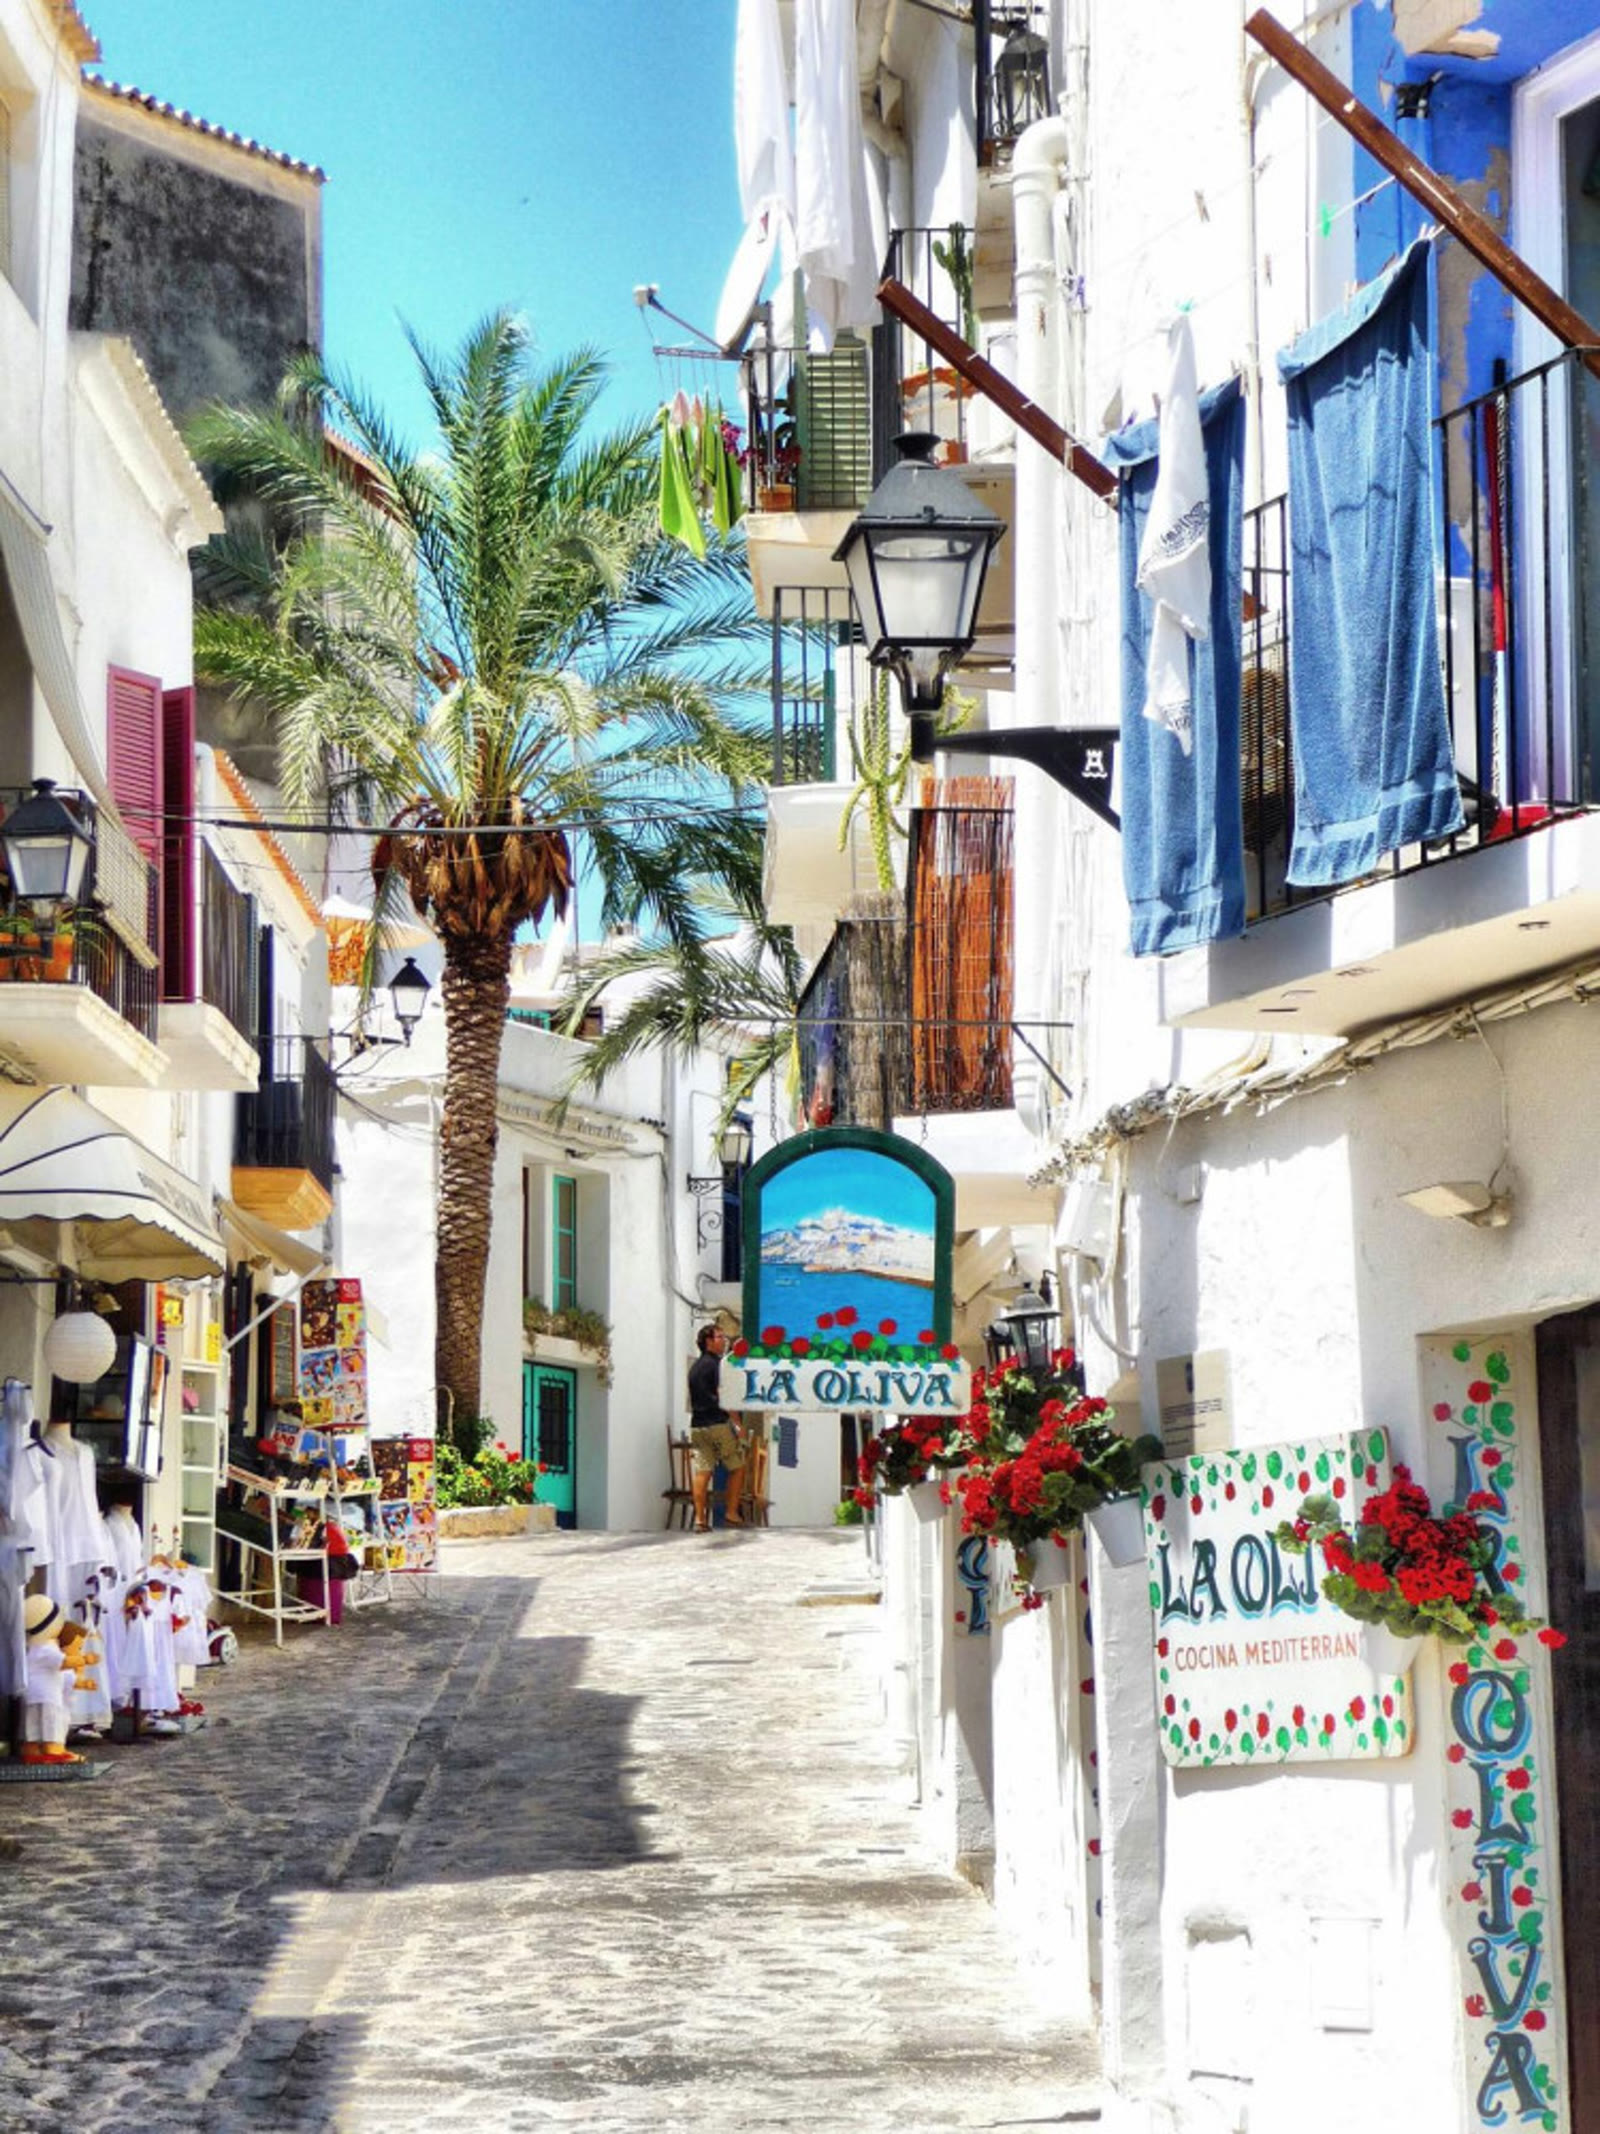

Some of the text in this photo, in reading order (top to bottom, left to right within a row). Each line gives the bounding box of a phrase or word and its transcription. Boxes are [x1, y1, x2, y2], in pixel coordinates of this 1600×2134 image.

[742, 1369, 955, 1407] LA OLIVA
[1157, 1528, 1322, 1621] LA OLI
[1174, 1630, 1363, 1671] COCINA MEDITERRAN
[1450, 1669, 1549, 2121] OLIVA
